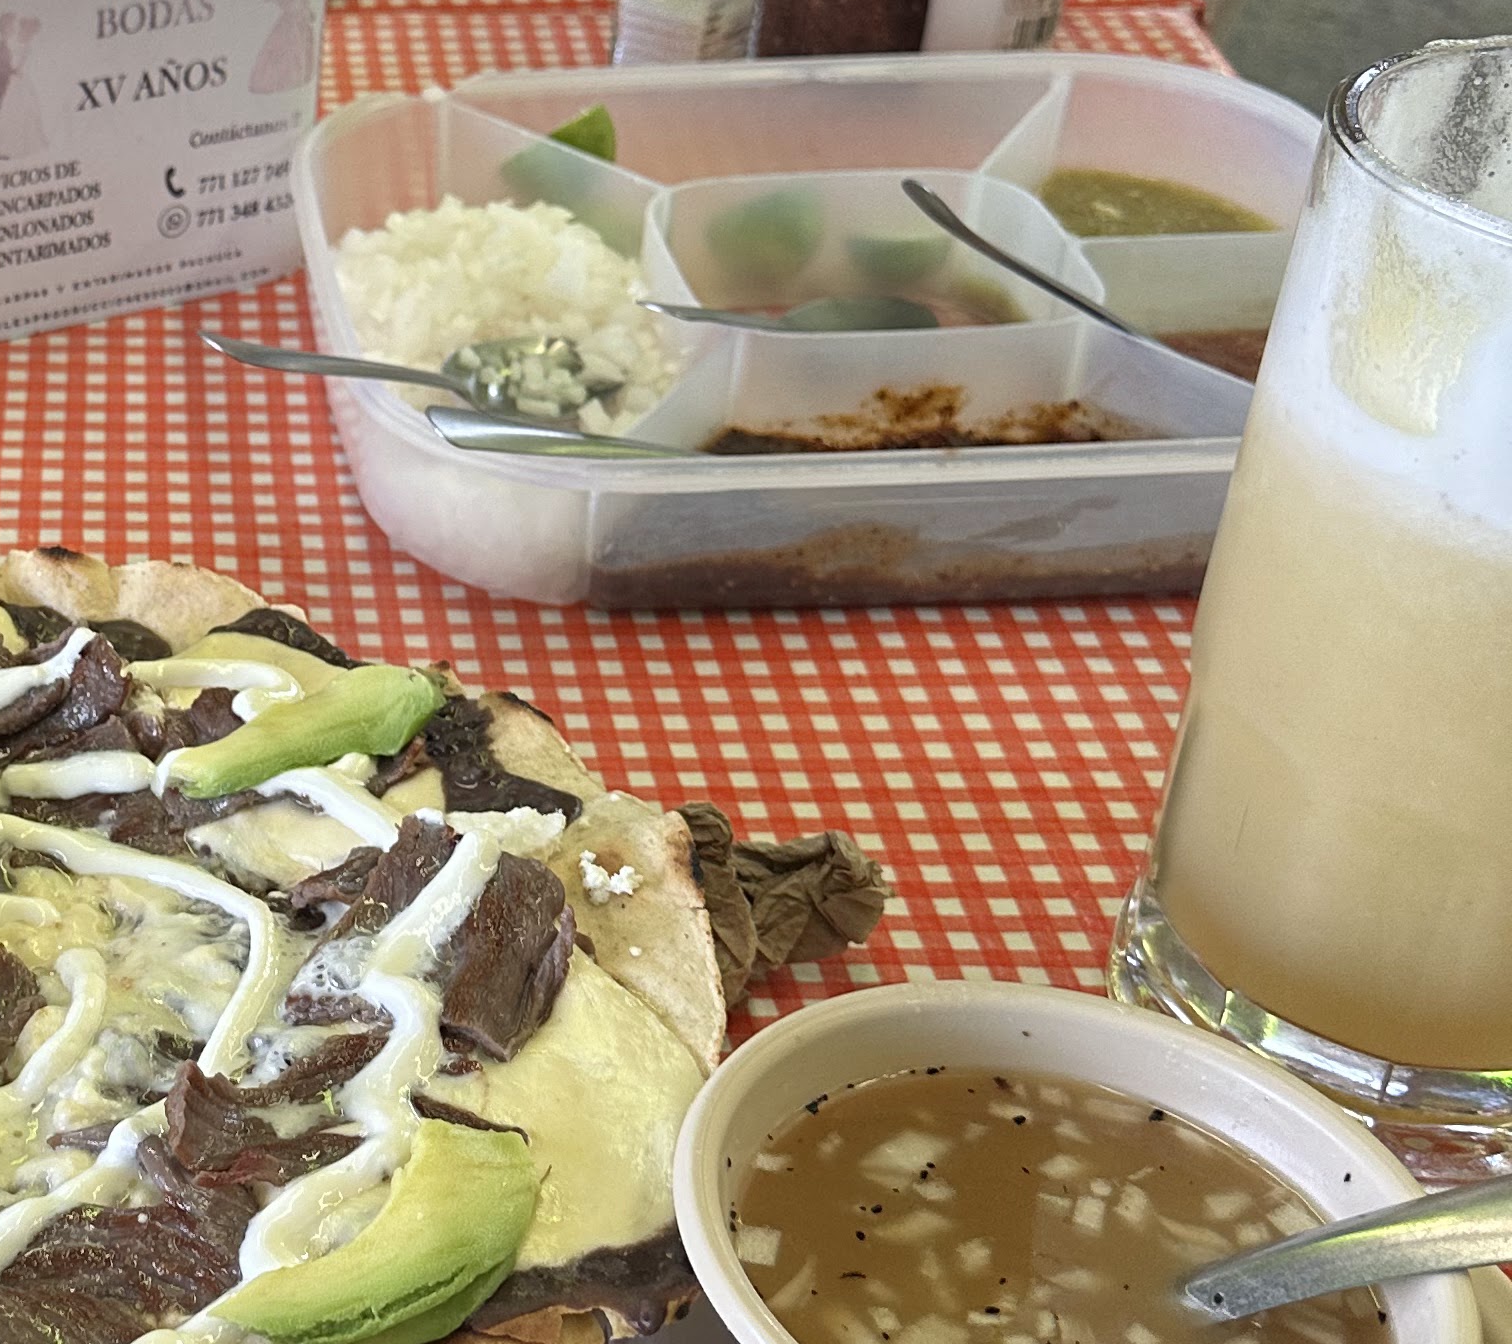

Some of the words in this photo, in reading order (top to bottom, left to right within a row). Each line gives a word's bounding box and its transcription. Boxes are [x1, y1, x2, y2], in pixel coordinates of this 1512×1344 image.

[76, 74, 126, 112] XV
[133, 56, 228, 102] AÑOS
[54, 160, 81, 180] DE
[199, 175, 226, 195] 771
[197, 208, 225, 228] 771
